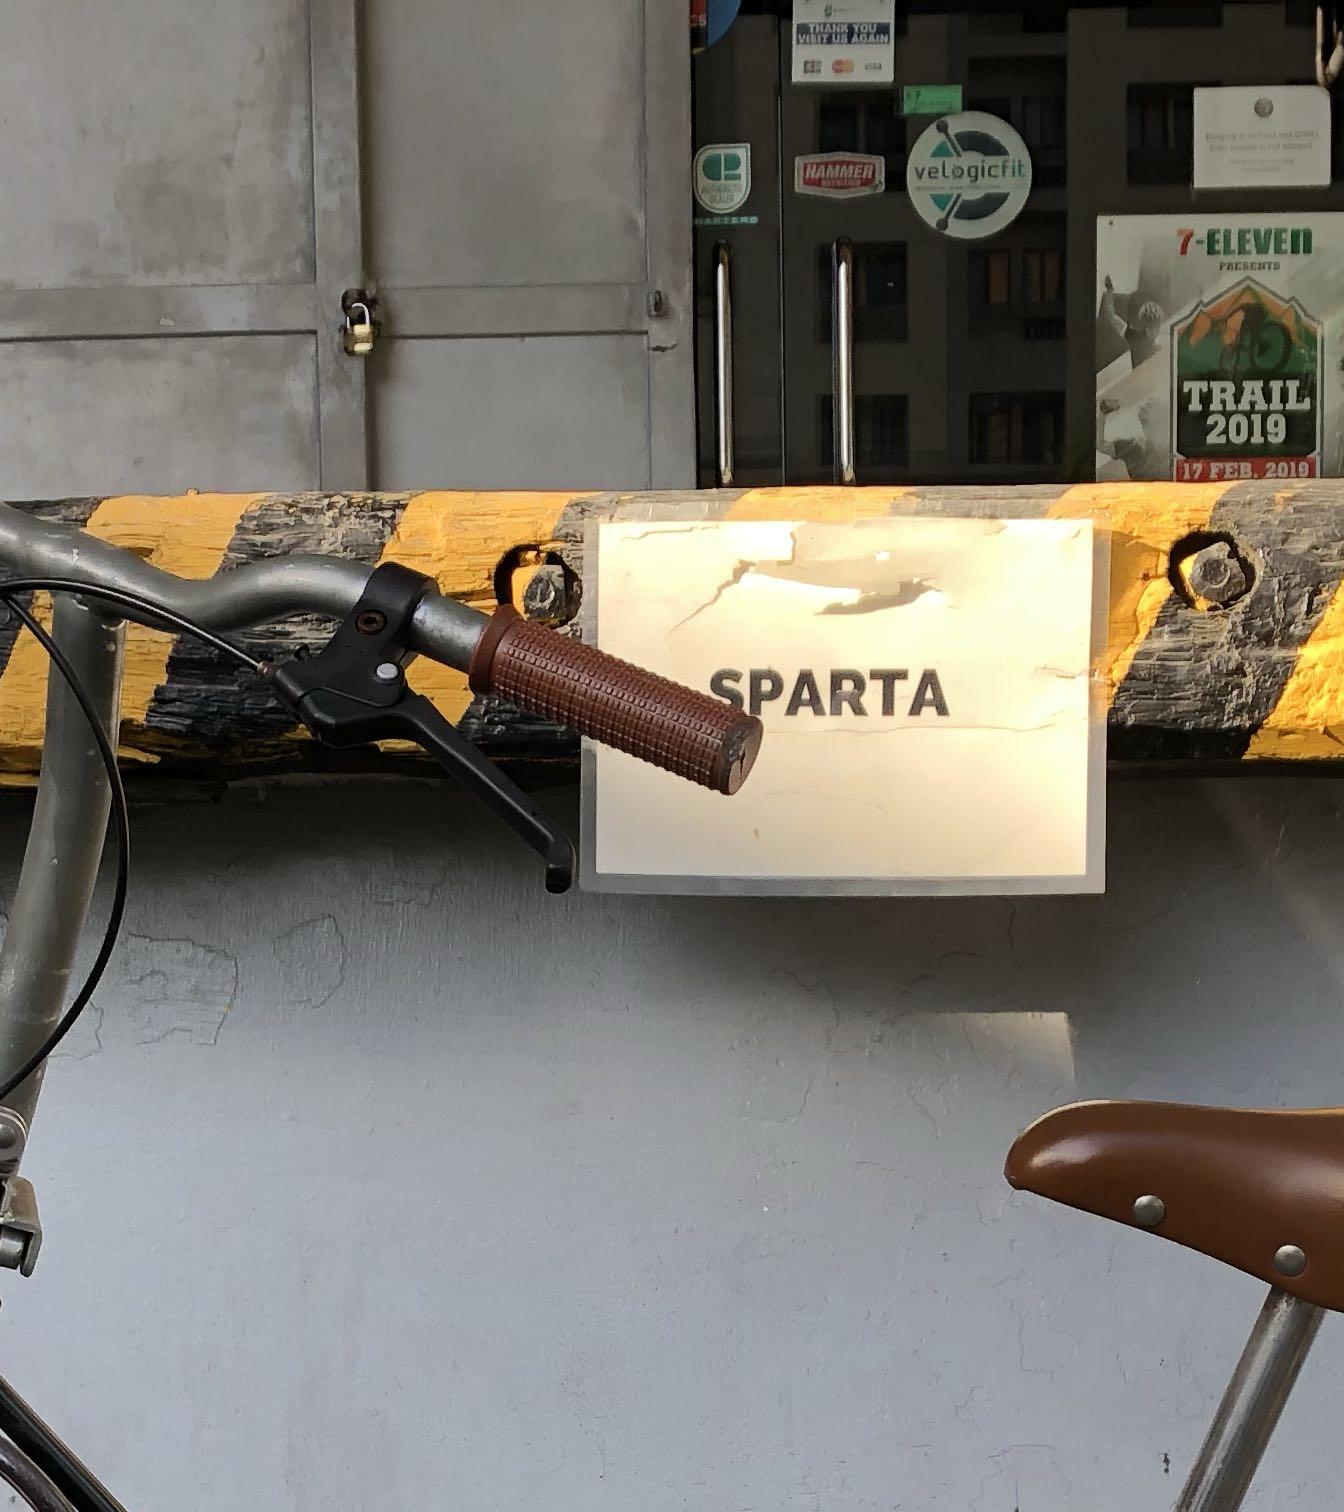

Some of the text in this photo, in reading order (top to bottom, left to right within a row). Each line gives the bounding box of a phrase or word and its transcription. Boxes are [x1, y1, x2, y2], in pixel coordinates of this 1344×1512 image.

[808, 23, 877, 33] THANK YOU
[798, 33, 889, 43] VISIT US AGAIN
[805, 164, 874, 179] HAMMER
[1219, 261, 1281, 271] PRESENTS
[1183, 380, 1311, 412] TRAIL
[1206, 413, 1286, 444] 2019
[1183, 463, 1203, 480] 17
[1263, 461, 1310, 479] 2019
[709, 667, 950, 718] SPARTA
